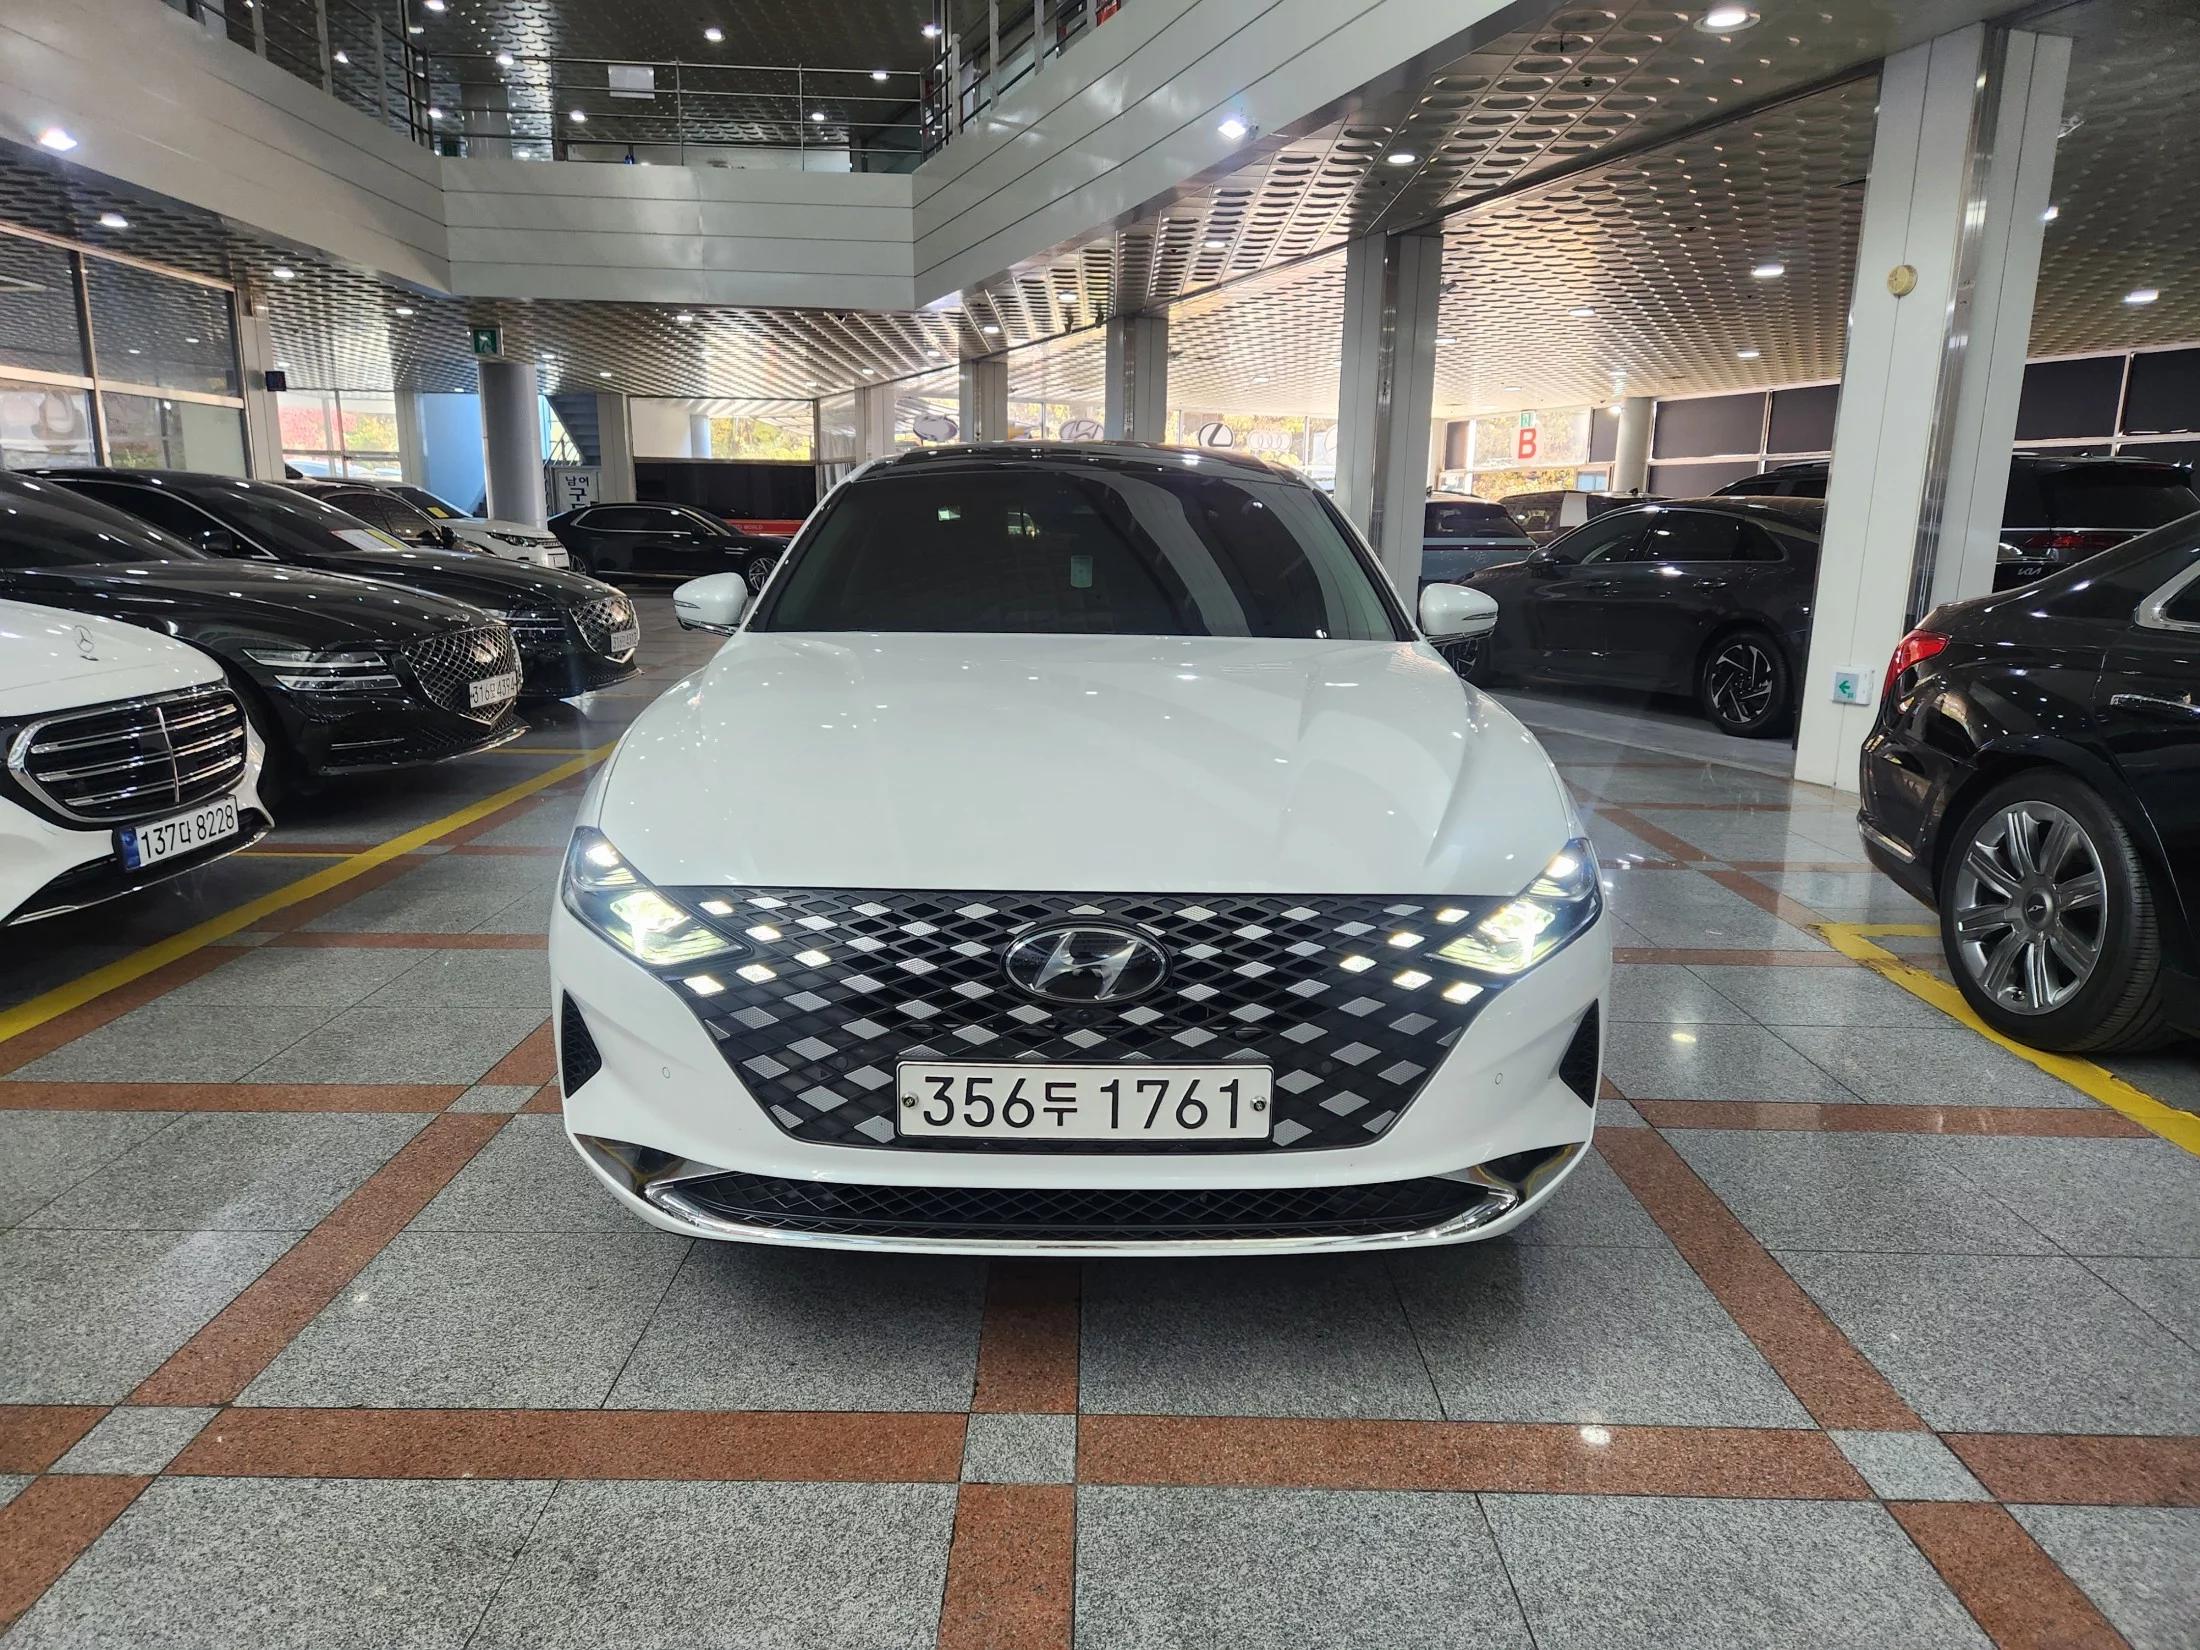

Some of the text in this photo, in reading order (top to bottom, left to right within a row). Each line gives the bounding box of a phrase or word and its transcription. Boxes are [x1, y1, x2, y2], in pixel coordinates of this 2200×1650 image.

[1518, 428, 1536, 459] B
[141, 804, 235, 858] 137다 8228
[923, 1076, 1240, 1130] 356두 1761
